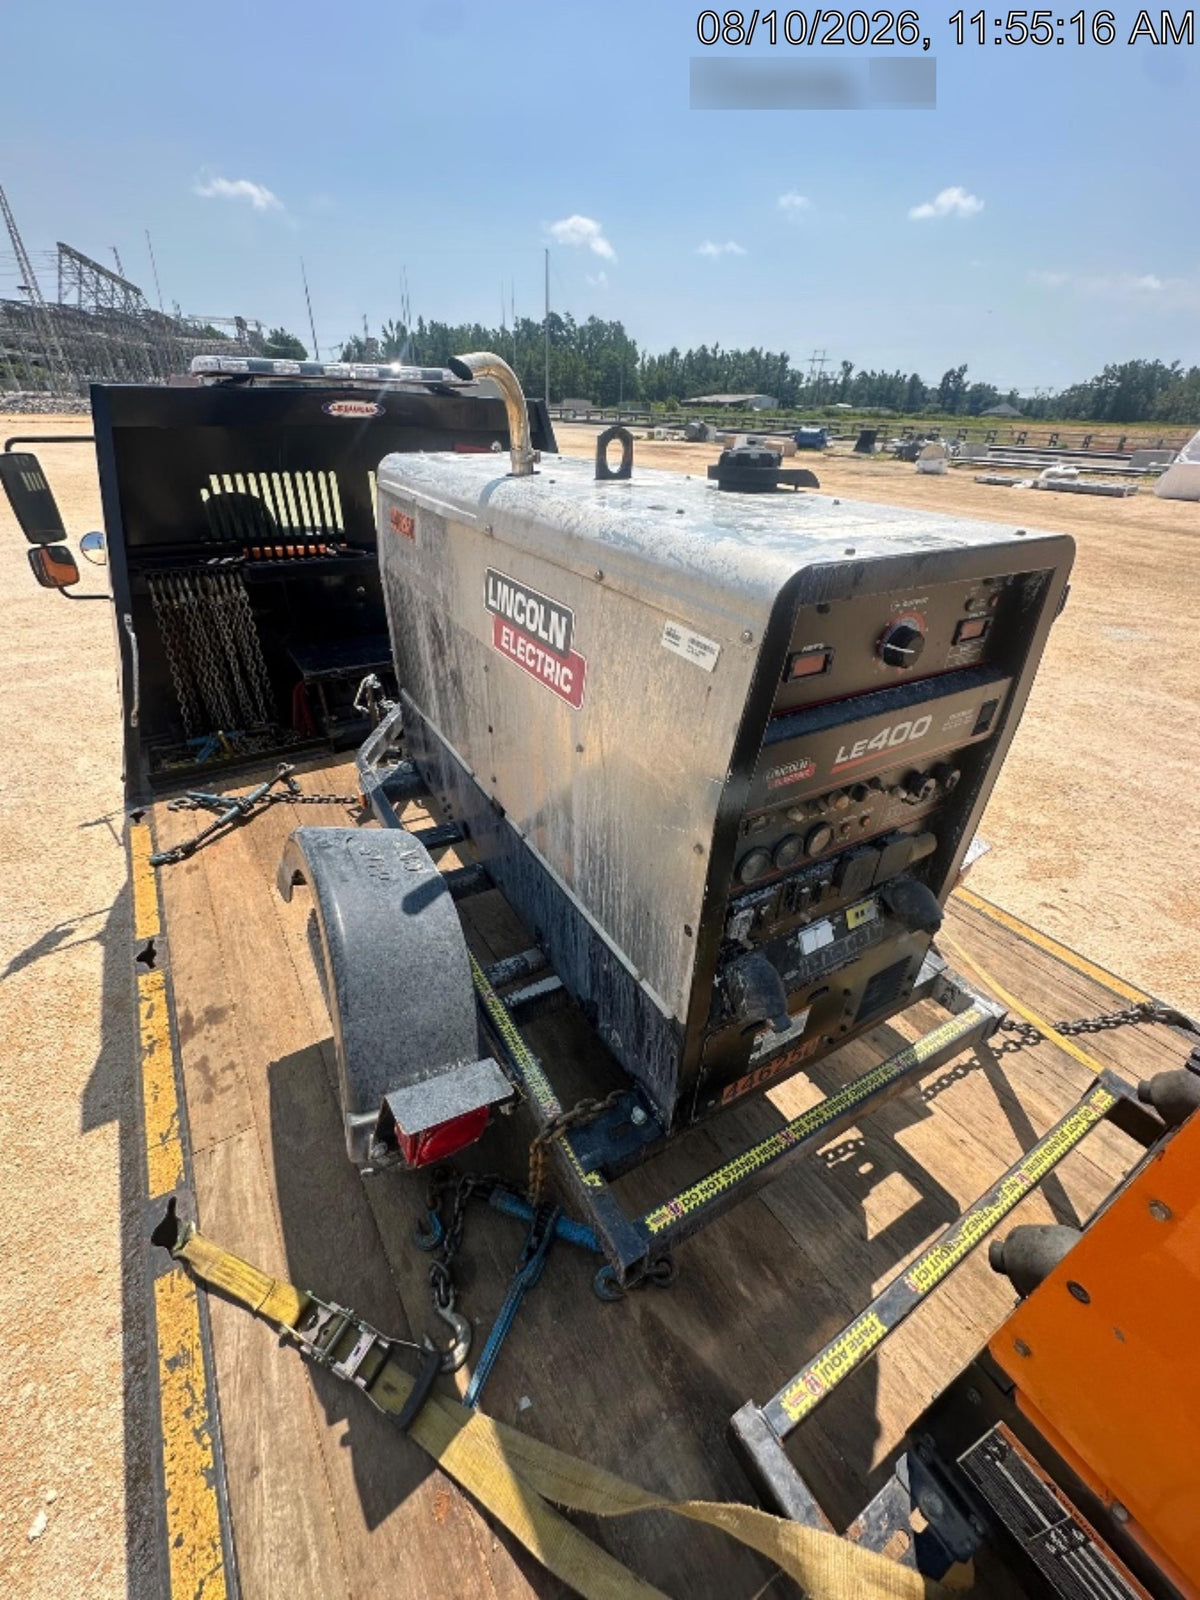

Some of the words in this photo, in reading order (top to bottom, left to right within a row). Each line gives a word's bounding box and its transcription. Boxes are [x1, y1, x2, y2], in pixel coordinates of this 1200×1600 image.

[488, 577, 568, 651] LINCOLN
[501, 625, 574, 694] ELECTRIC
[835, 714, 933, 764] LE400
[680, 1191, 699, 1207] DO
[698, 1176, 723, 1195] NOT
[721, 1155, 757, 1181] STAND
[1003, 1178, 1019, 1195] NE
[914, 1265, 931, 1283] ICI
[845, 1320, 879, 1353] PARE
